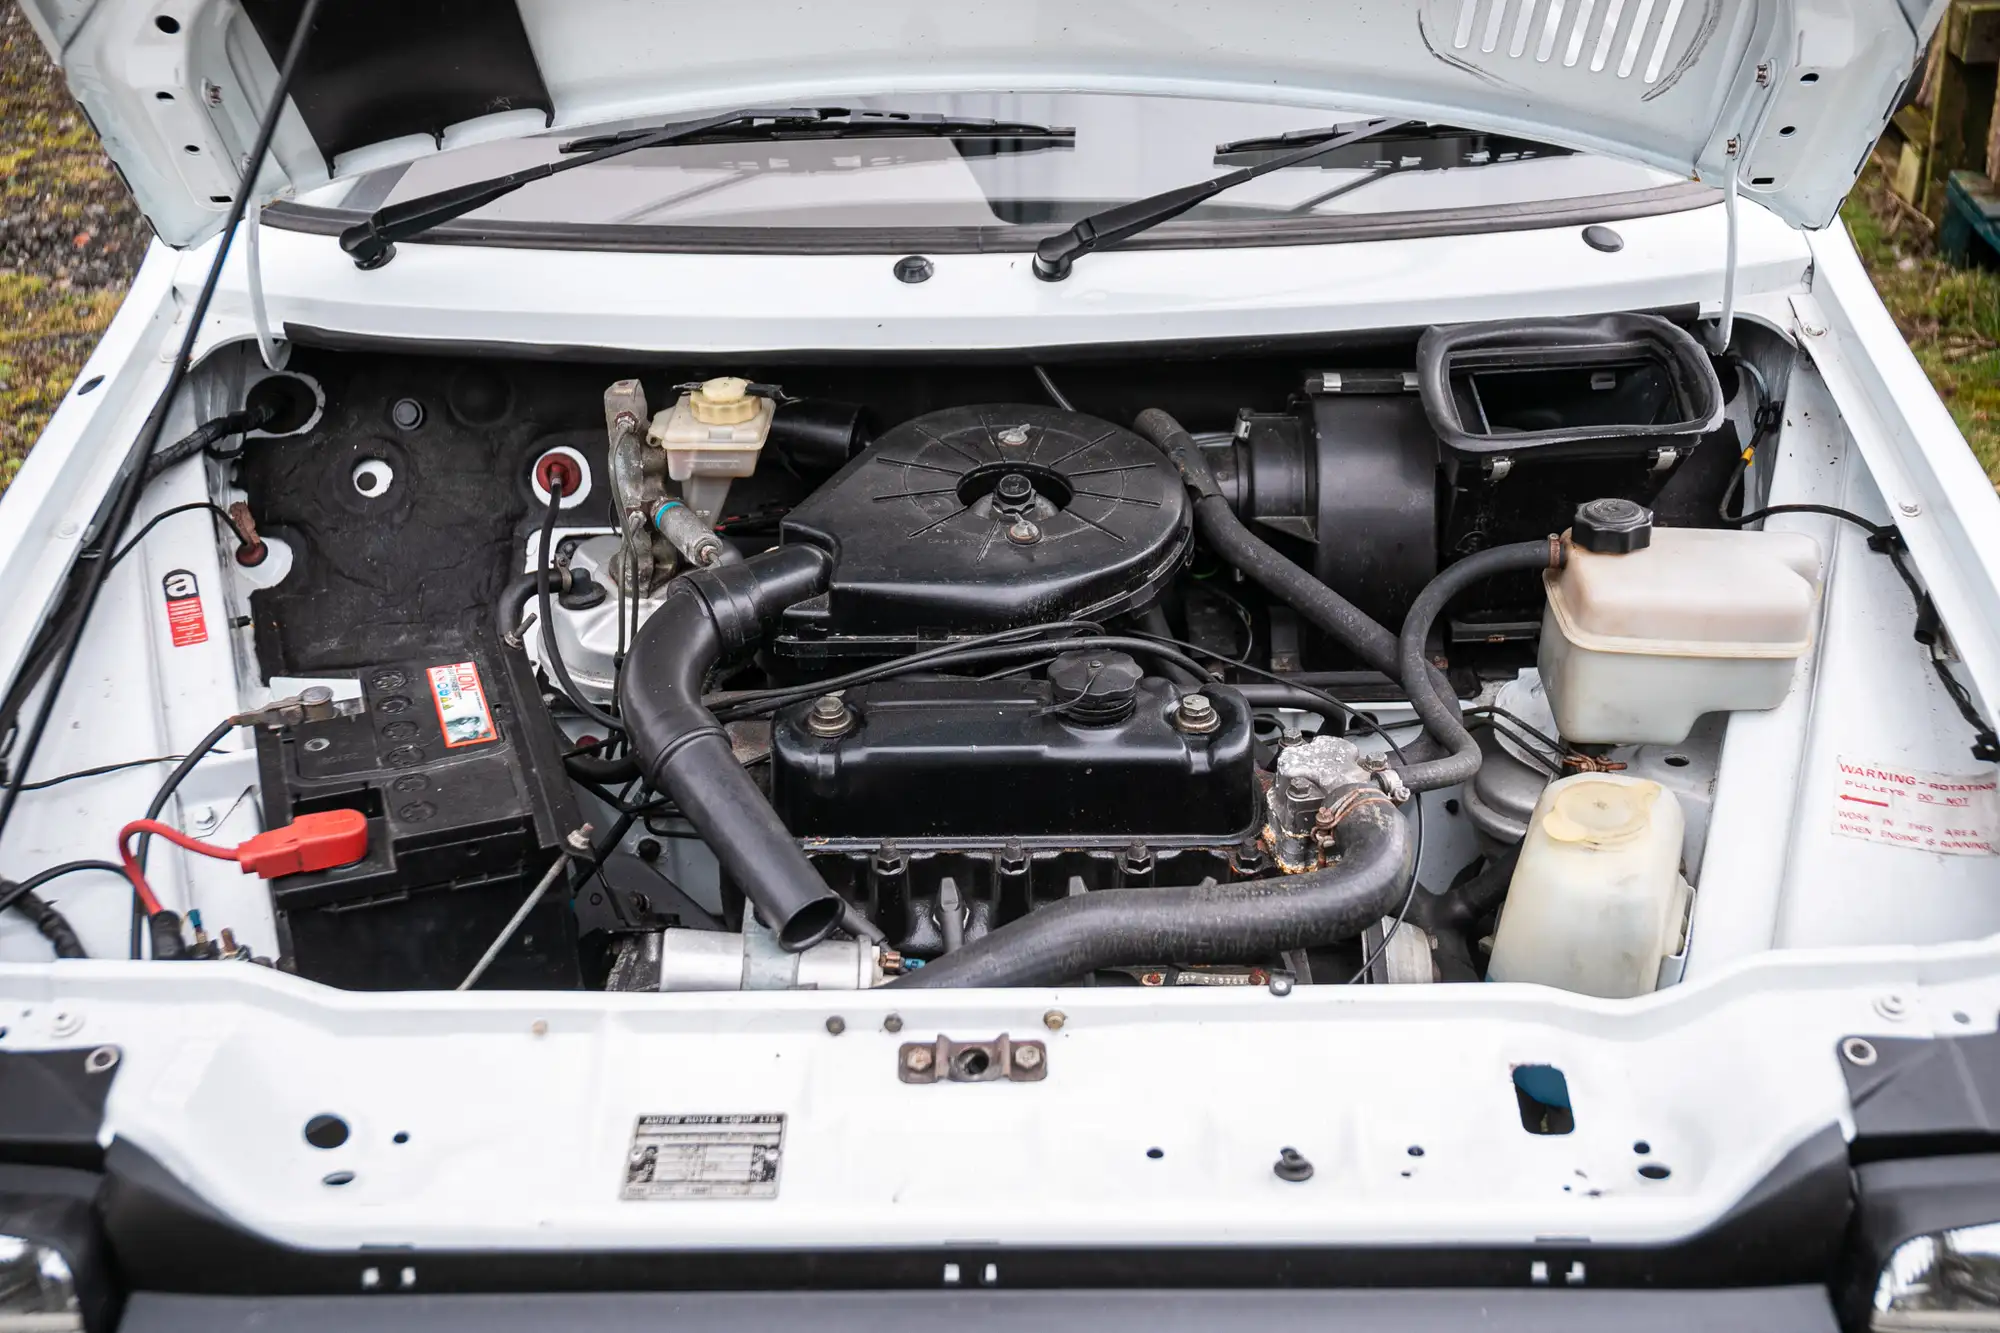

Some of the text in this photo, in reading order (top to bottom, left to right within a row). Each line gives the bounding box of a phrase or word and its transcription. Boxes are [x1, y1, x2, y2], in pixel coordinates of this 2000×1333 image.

[1840, 763, 1916, 786] WARNING
[1917, 793, 1934, 802] DO
[1946, 797, 1970, 806] NOT
[1838, 811, 1979, 838] WORK IN THIS AREA
[1839, 823, 1992, 850] WHEN ENGINE IS RUNNING
[644, 1115, 680, 1124] AUSTIN
[684, 1115, 718, 1124] ROVER
